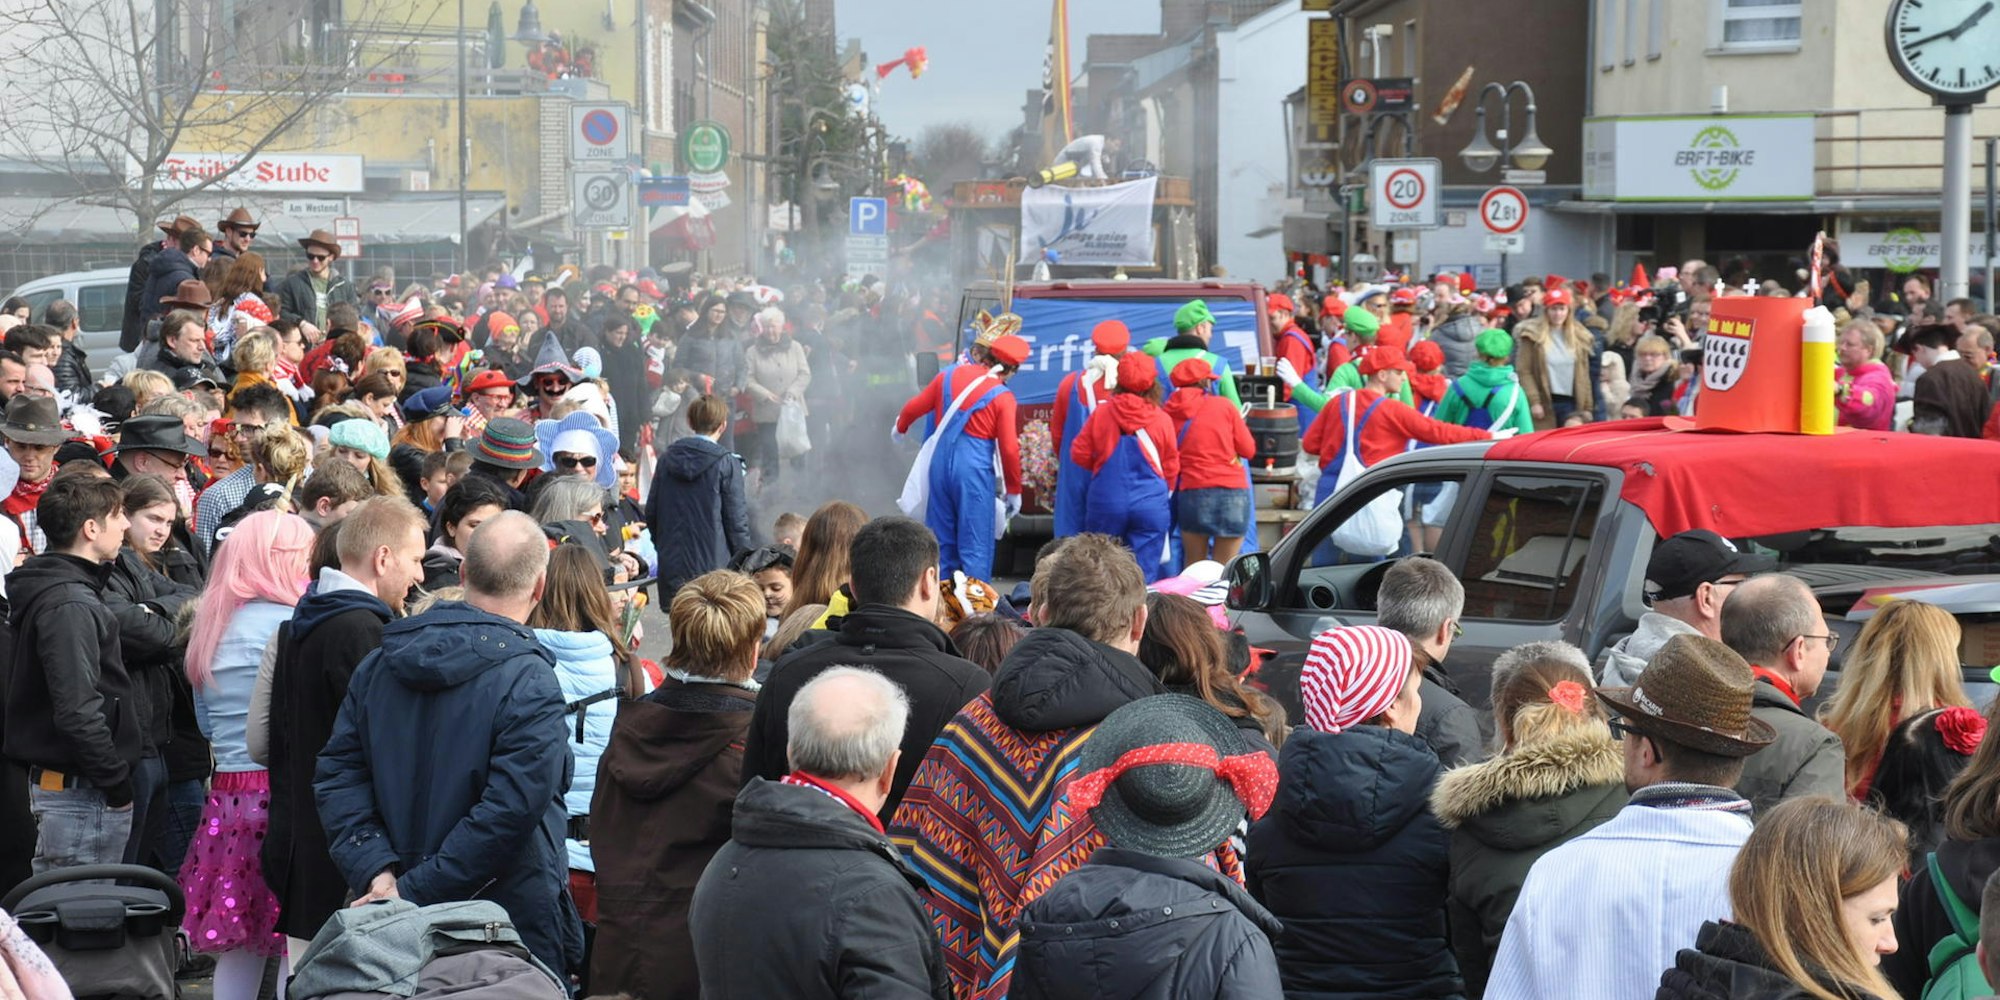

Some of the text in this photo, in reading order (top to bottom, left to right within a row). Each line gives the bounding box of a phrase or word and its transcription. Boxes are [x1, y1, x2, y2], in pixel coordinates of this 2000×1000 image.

[586, 148, 614, 157] ZONE
[1675, 150, 1755, 166] ERFT-BIKE
[256, 160, 330, 183] Stube
[591, 184, 612, 201] 30
[1393, 179, 1417, 199] 20
[289, 203, 338, 213] Am Westend
[859, 202, 877, 230] P
[1390, 211, 1420, 223] ZONE
[1868, 245, 1939, 255] ERFT-BIKE
[1013, 334, 1097, 371] Erft
